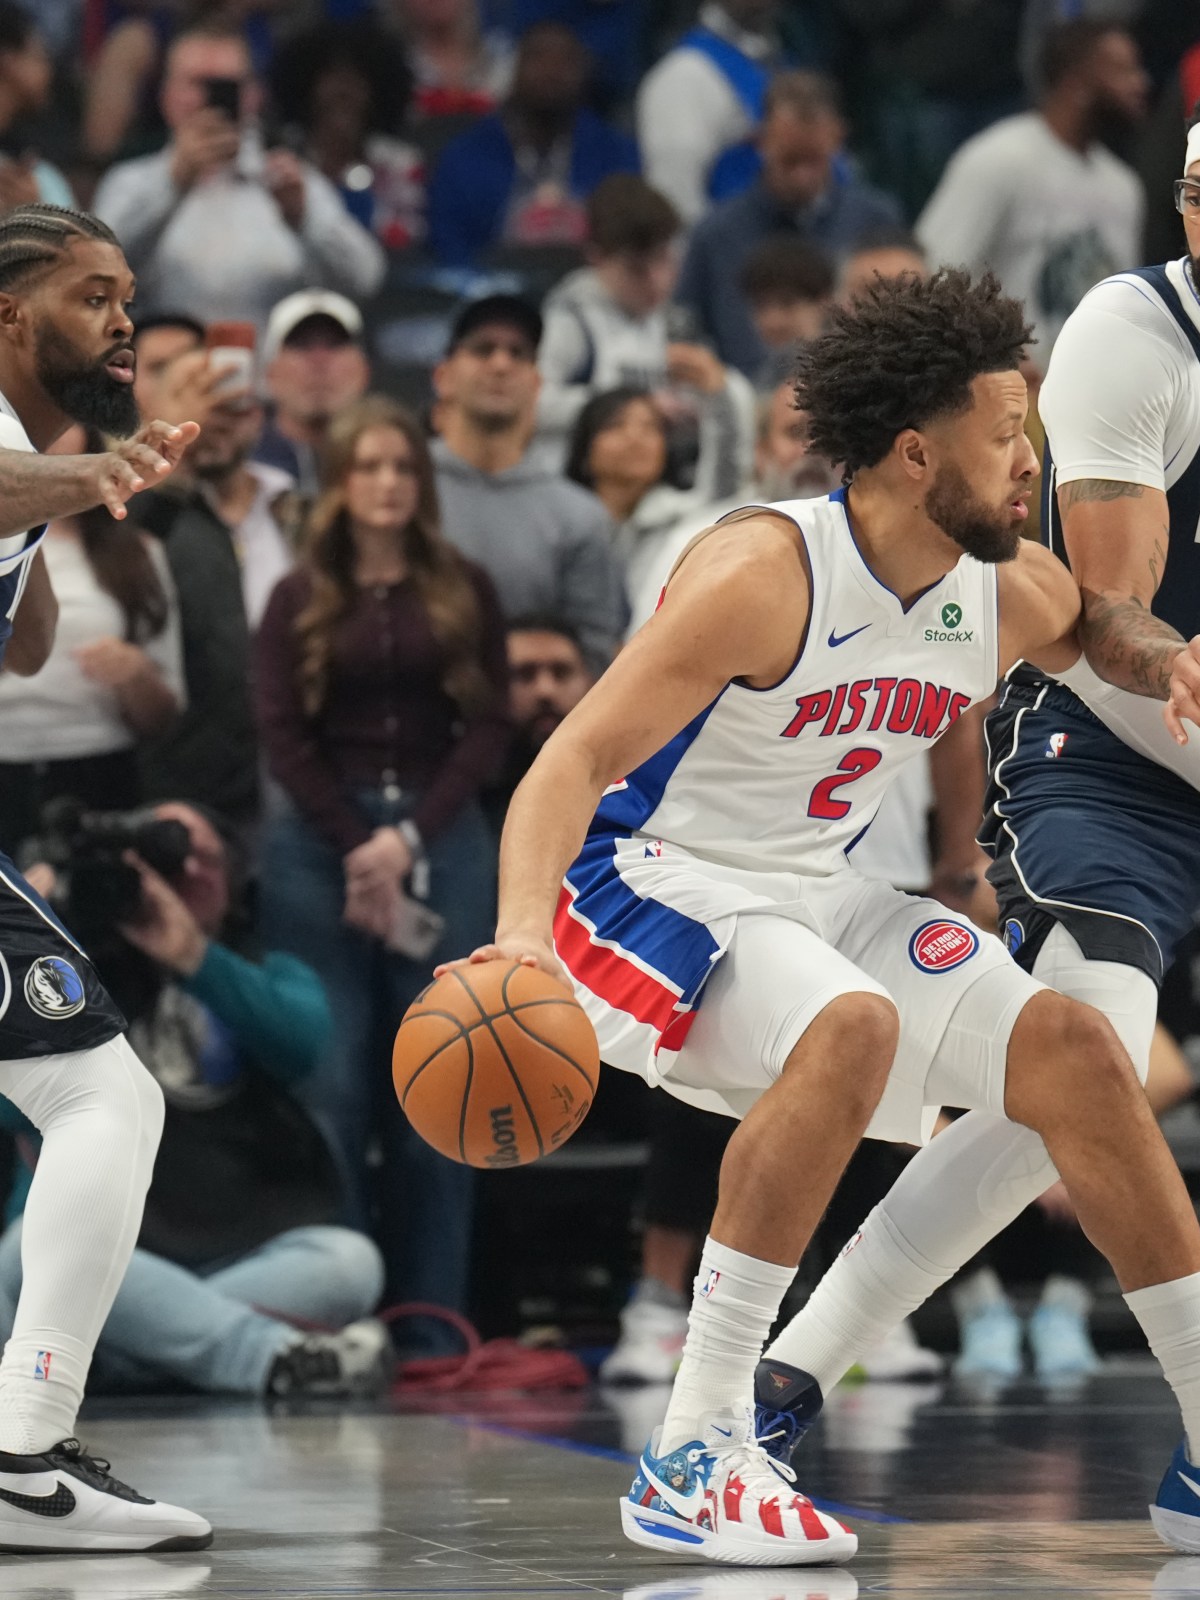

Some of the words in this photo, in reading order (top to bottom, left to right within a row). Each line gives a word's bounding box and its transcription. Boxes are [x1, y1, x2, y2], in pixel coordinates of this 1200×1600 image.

[924, 629, 973, 642] StockX
[779, 677, 972, 739] PISTONS
[807, 747, 882, 820] 2
[921, 929, 959, 956] DETROIT
[928, 934, 967, 962] PISTONS
[484, 1104, 519, 1168] lson
